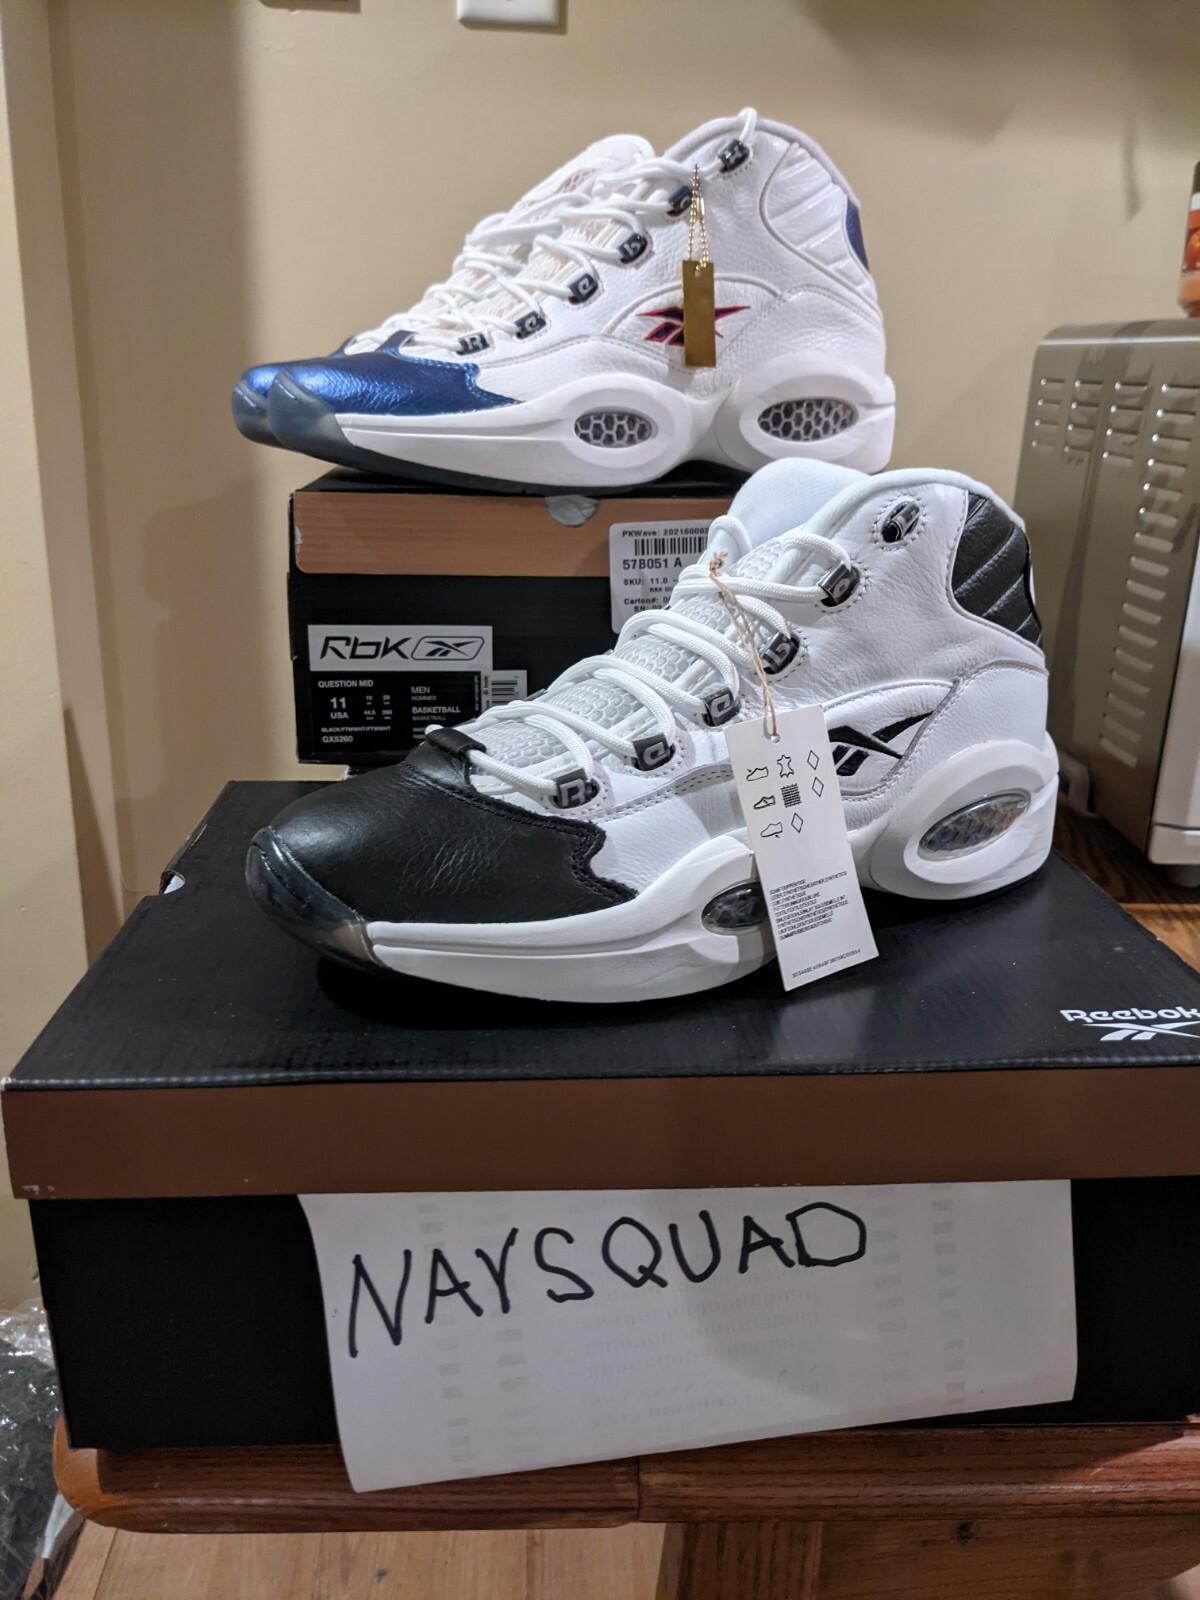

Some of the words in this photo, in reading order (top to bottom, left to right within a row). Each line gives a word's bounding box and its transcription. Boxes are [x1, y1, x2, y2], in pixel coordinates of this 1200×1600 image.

[622, 558, 668, 570] 57B051
[673, 557, 682, 568] A
[623, 578, 645, 586] SKU:
[650, 577, 668, 585] 11.0
[623, 597, 659, 605] Carton#:
[318, 680, 358, 688] QUESTION
[359, 679, 374, 688] MID
[411, 686, 430, 694] MEN
[330, 697, 347, 710] 11
[412, 706, 461, 714] BASKETBALL
[330, 711, 349, 720] USA
[322, 735, 354, 743] GX5260
[1060, 1006, 1200, 1023] Reebok
[348, 1202, 867, 1358] NAYSQUAD
